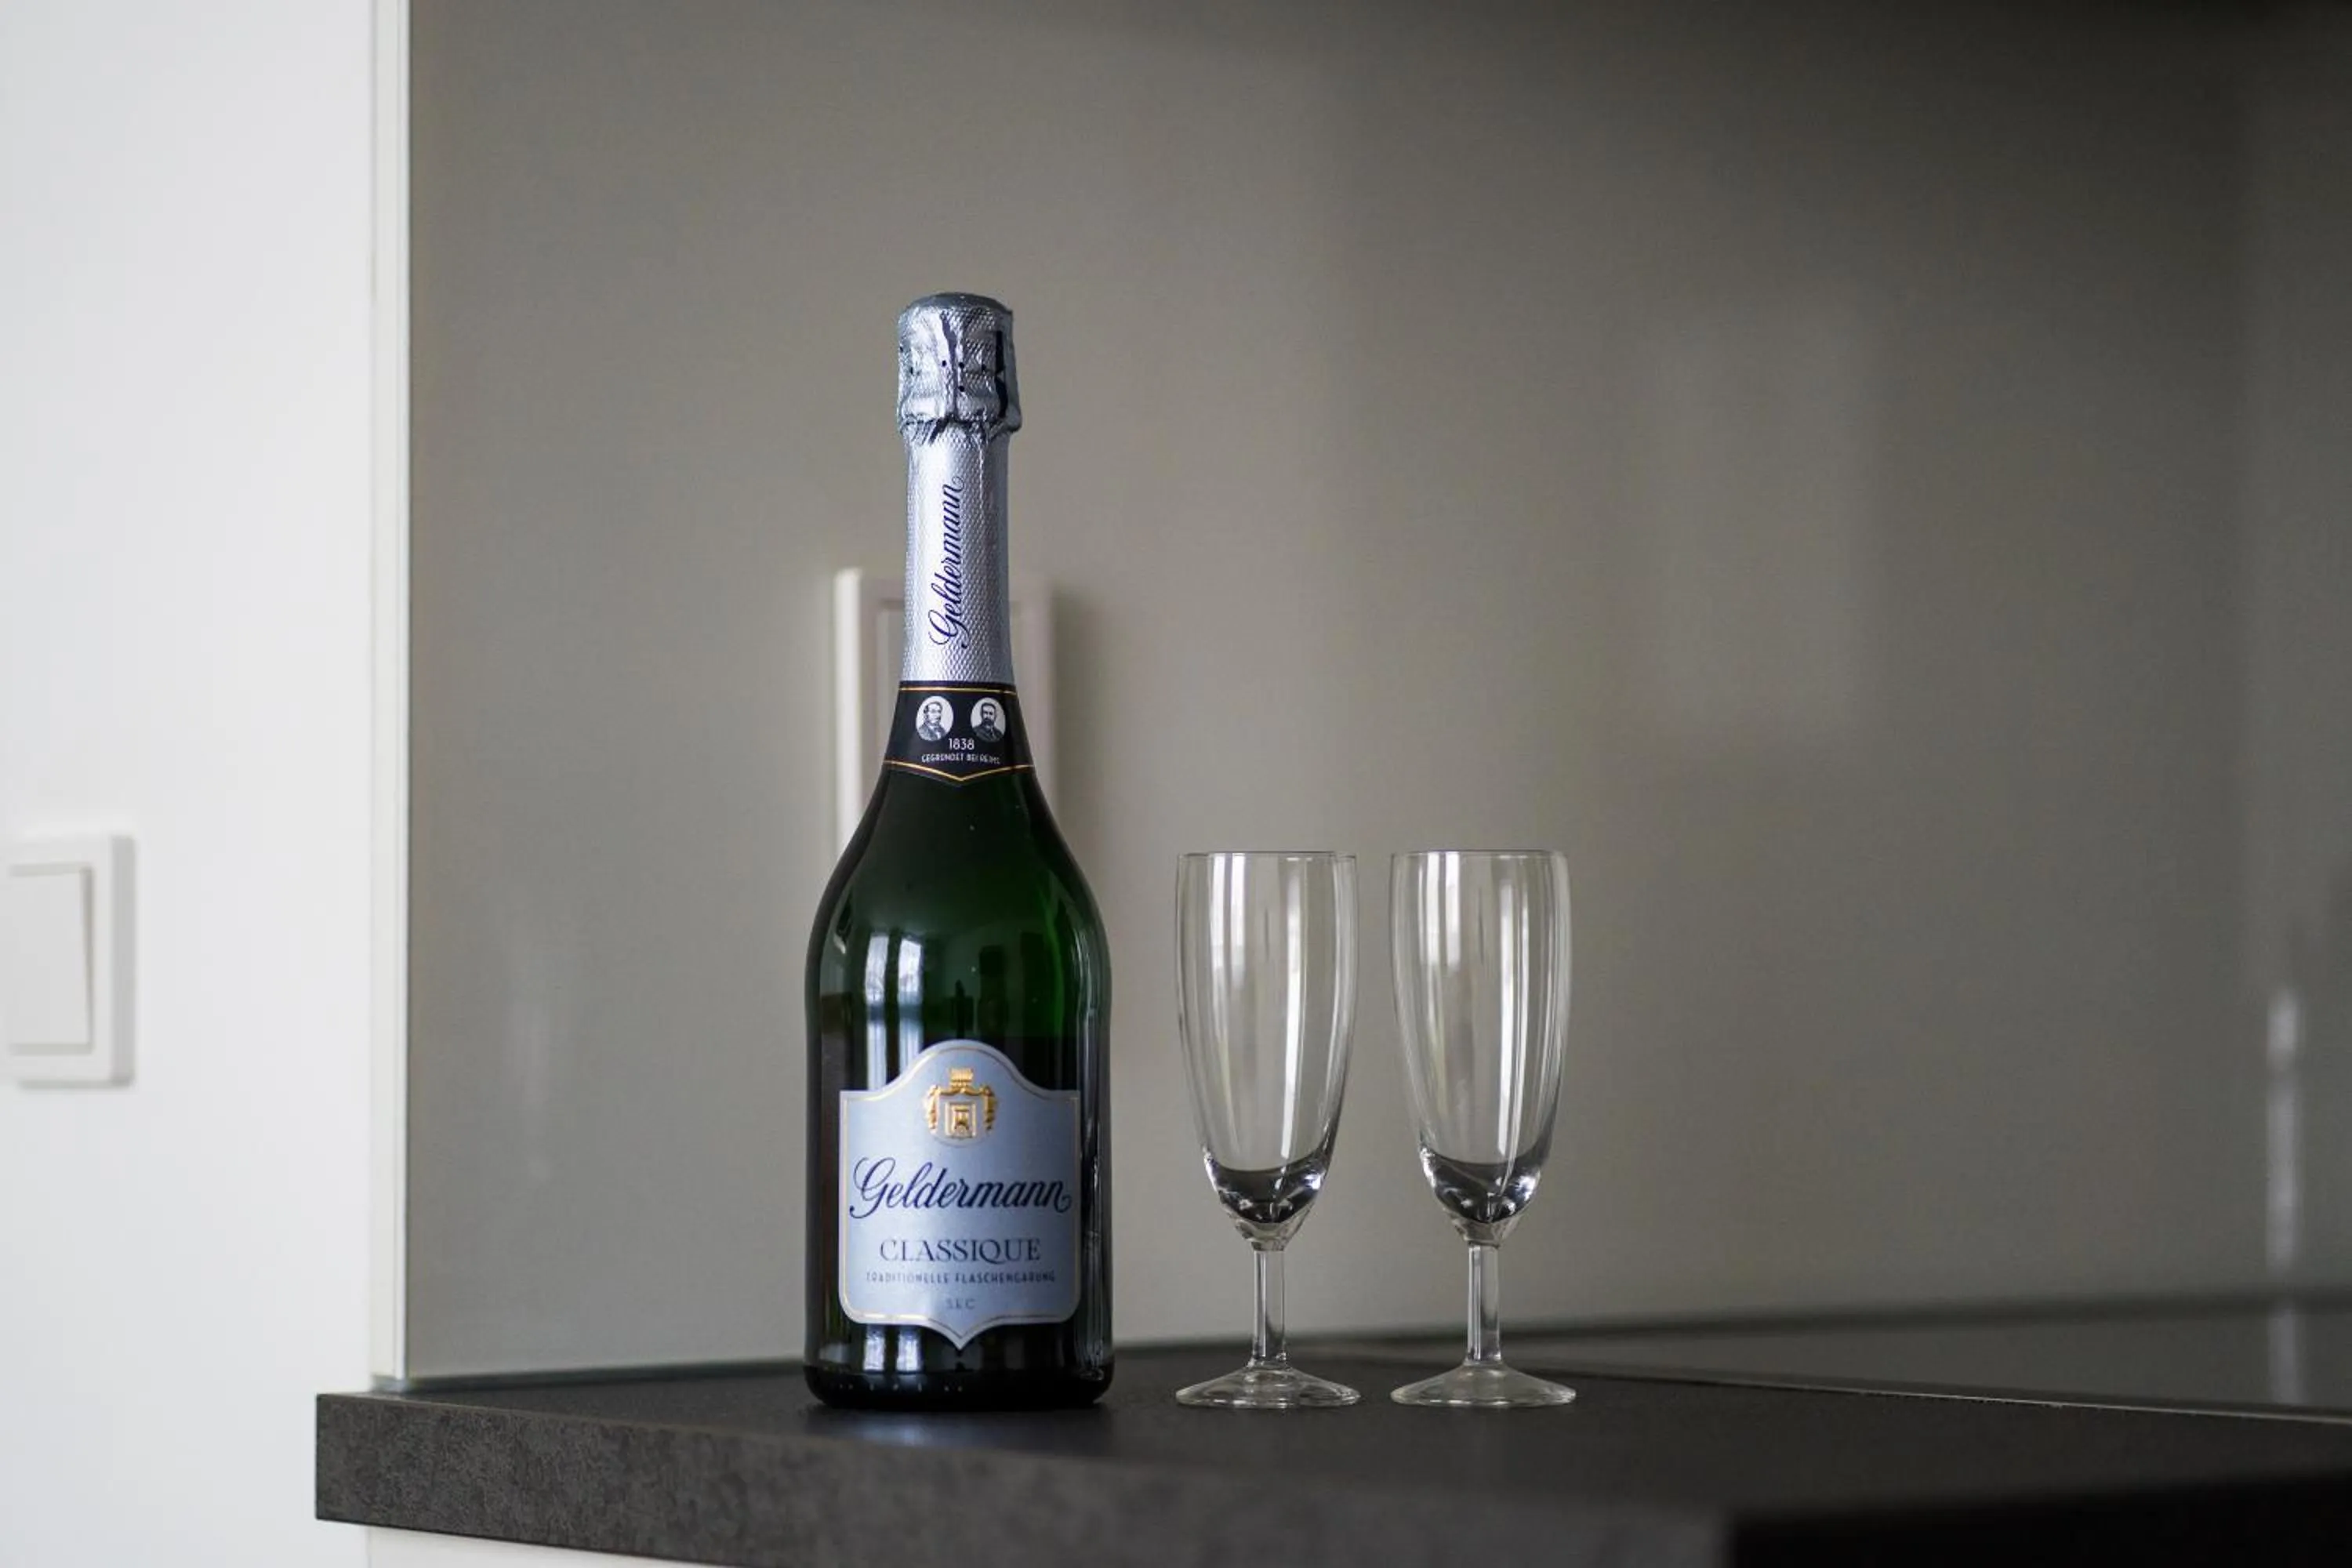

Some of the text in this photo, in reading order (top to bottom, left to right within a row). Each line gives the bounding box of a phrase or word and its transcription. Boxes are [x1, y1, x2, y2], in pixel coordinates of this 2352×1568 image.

[928, 477, 969, 648] Geldermann
[948, 738, 975, 750] 1838
[850, 1156, 1072, 1219] Geldermann
[880, 1238, 1041, 1265] CLASSIQUE
[866, 1272, 949, 1284] TRADITIONELLE
[946, 1298, 975, 1310] SEC
